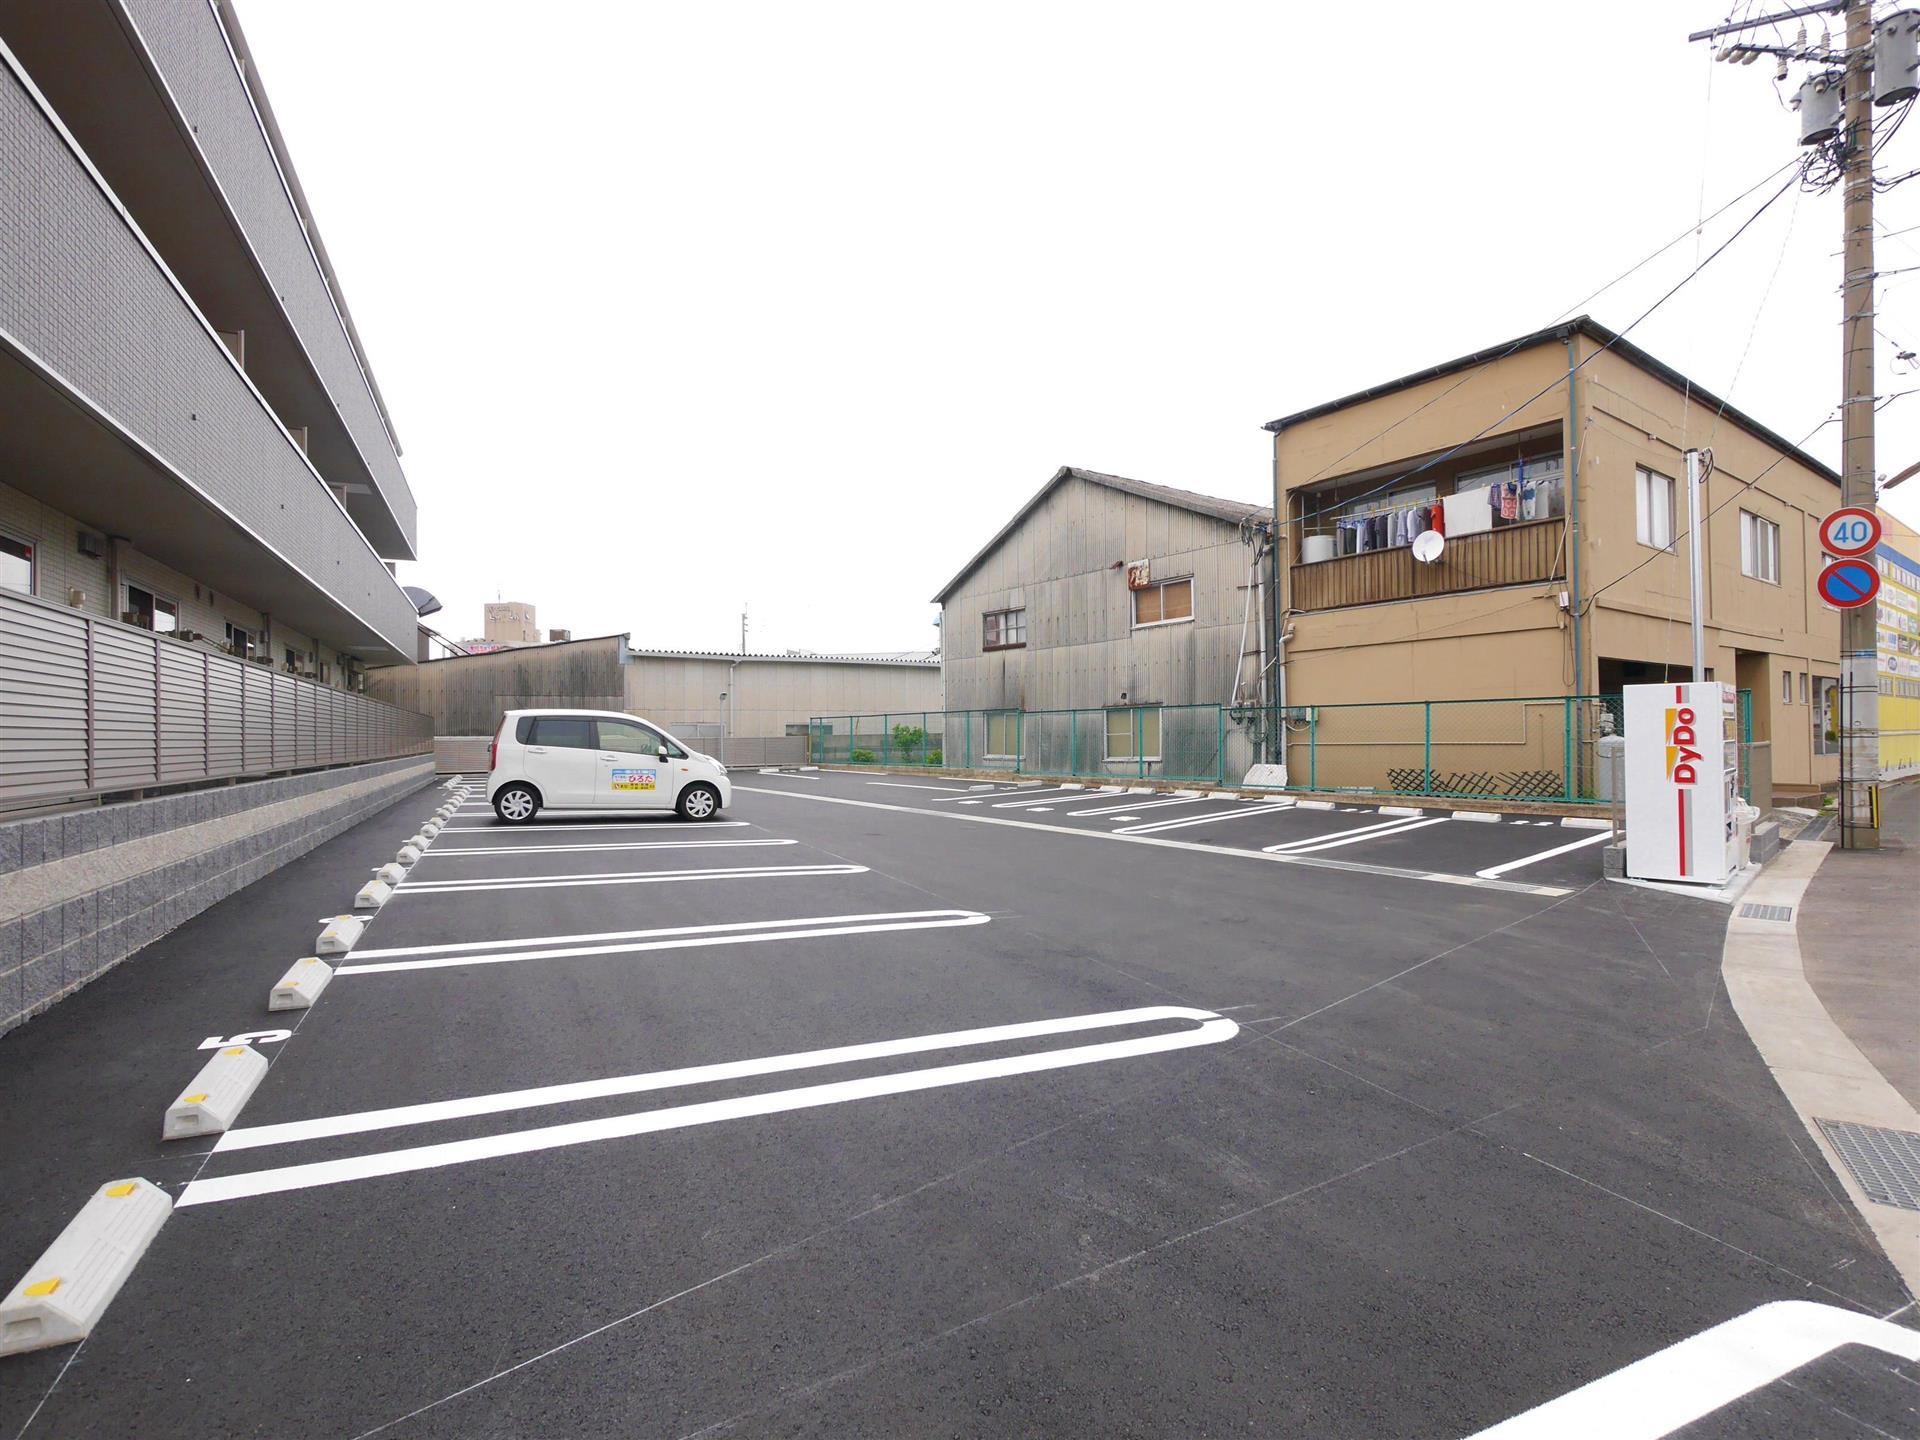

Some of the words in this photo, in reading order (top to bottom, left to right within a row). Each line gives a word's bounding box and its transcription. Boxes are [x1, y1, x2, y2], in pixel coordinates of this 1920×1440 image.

[1833, 521, 1868, 543] 40
[1673, 707, 1703, 784] DyDo
[197, 1029, 292, 1049] 5
